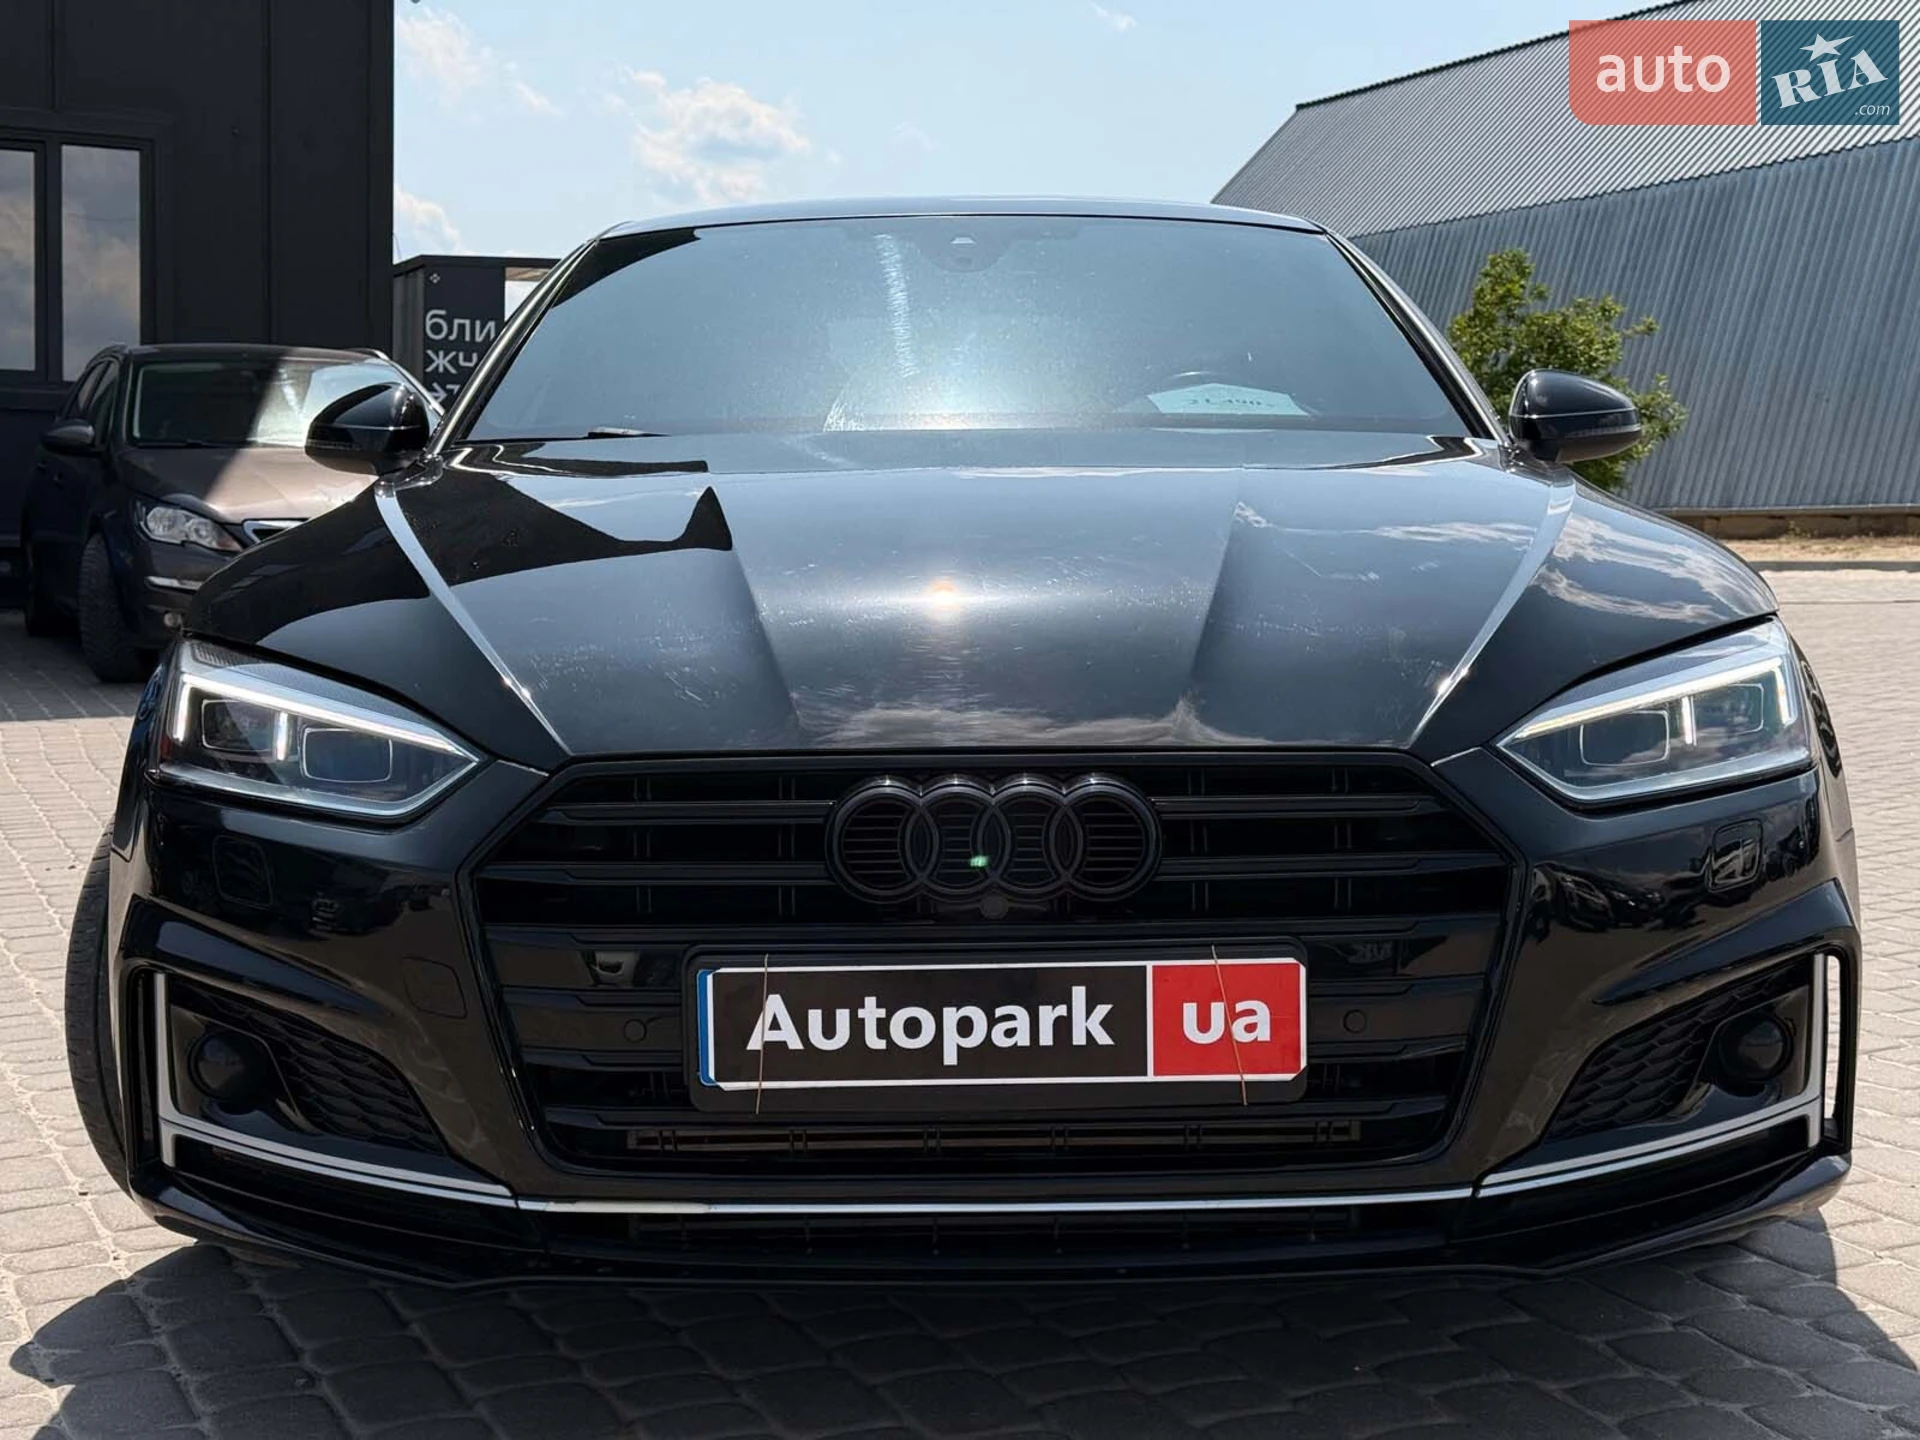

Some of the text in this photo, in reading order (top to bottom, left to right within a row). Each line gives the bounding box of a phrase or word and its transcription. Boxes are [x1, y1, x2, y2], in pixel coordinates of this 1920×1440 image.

[425, 309, 496, 342] бли
[746, 985, 1272, 1067] Autopark ua
